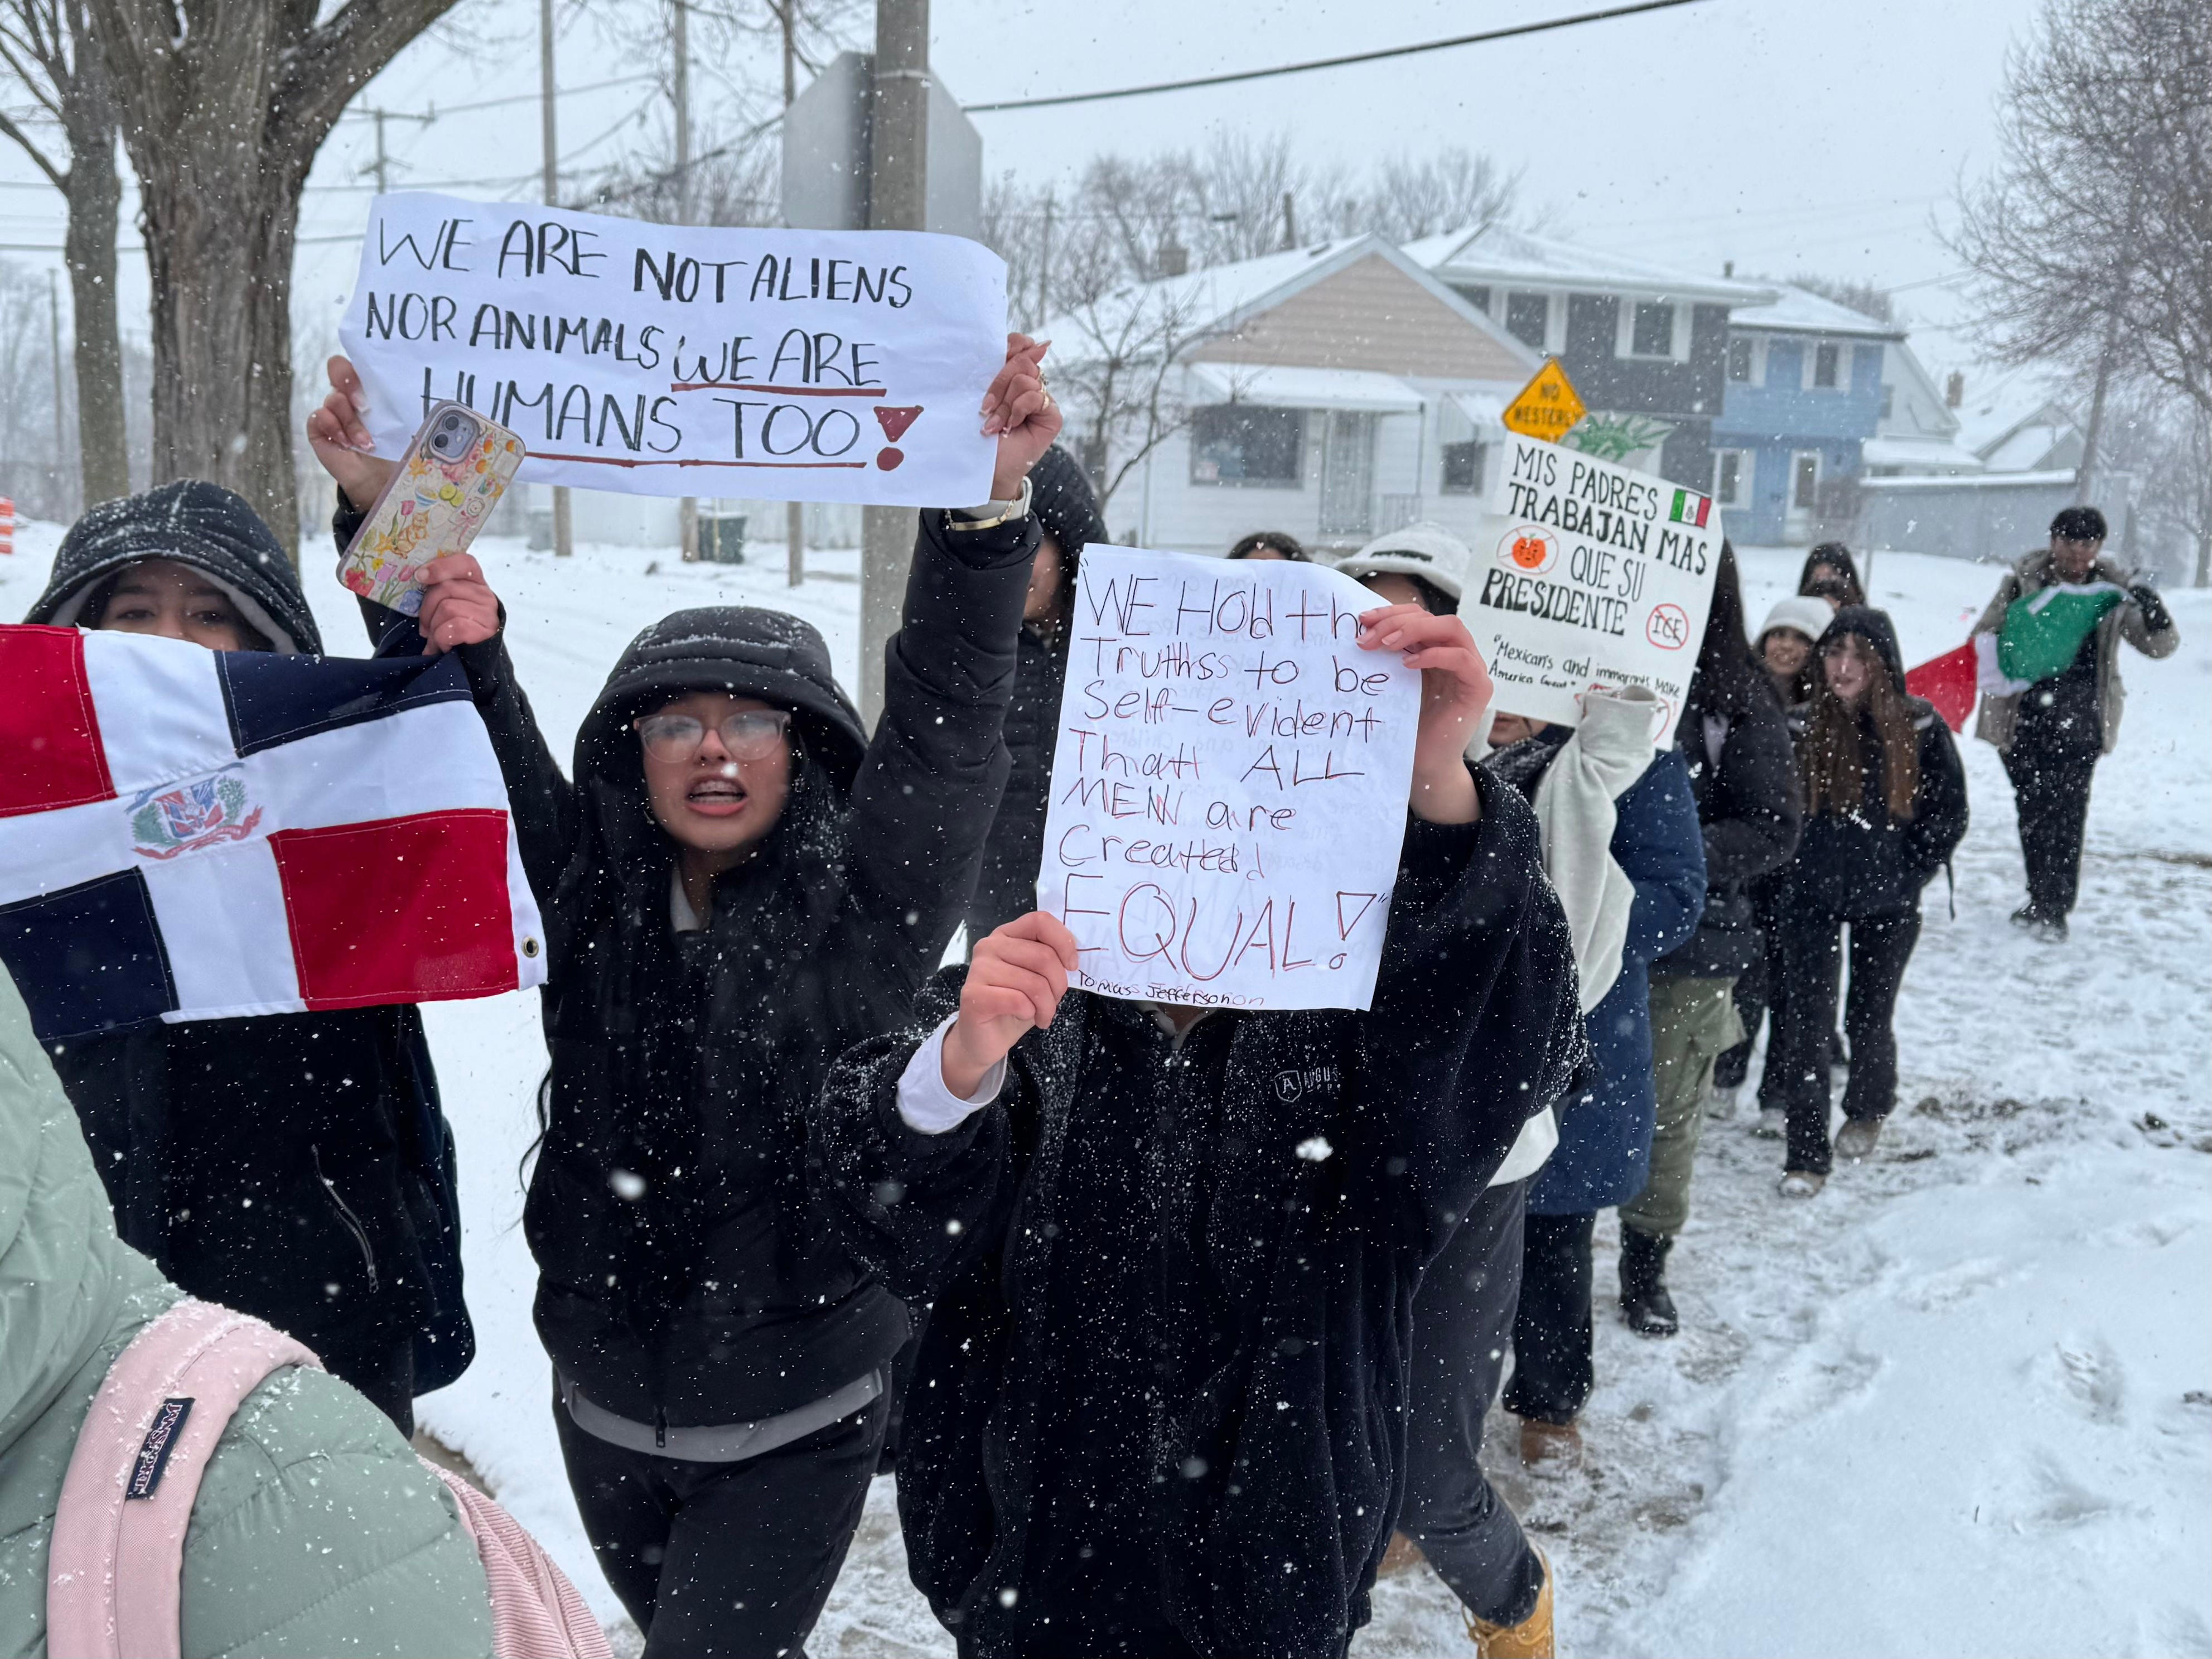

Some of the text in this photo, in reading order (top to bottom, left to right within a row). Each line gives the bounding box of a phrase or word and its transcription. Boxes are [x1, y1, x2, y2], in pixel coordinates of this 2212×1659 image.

[379, 216, 912, 308] WE ARE NOT ALIENS
[365, 291, 881, 387] NOR ANIMALS WE ARE
[1513, 443, 1658, 522] MIS PADRES
[1509, 482, 1707, 576] TRABAJAN MAS
[1480, 568, 1628, 636] PRESIDENTE
[1570, 544, 1646, 603] QUE SU
[1651, 614, 1683, 639] ICE
[1244, 650, 1300, 691] to
[1334, 655, 1390, 696] be
[1562, 657, 1591, 678] and
[1240, 745, 1365, 791] ALL
[1205, 801, 1295, 830] are
